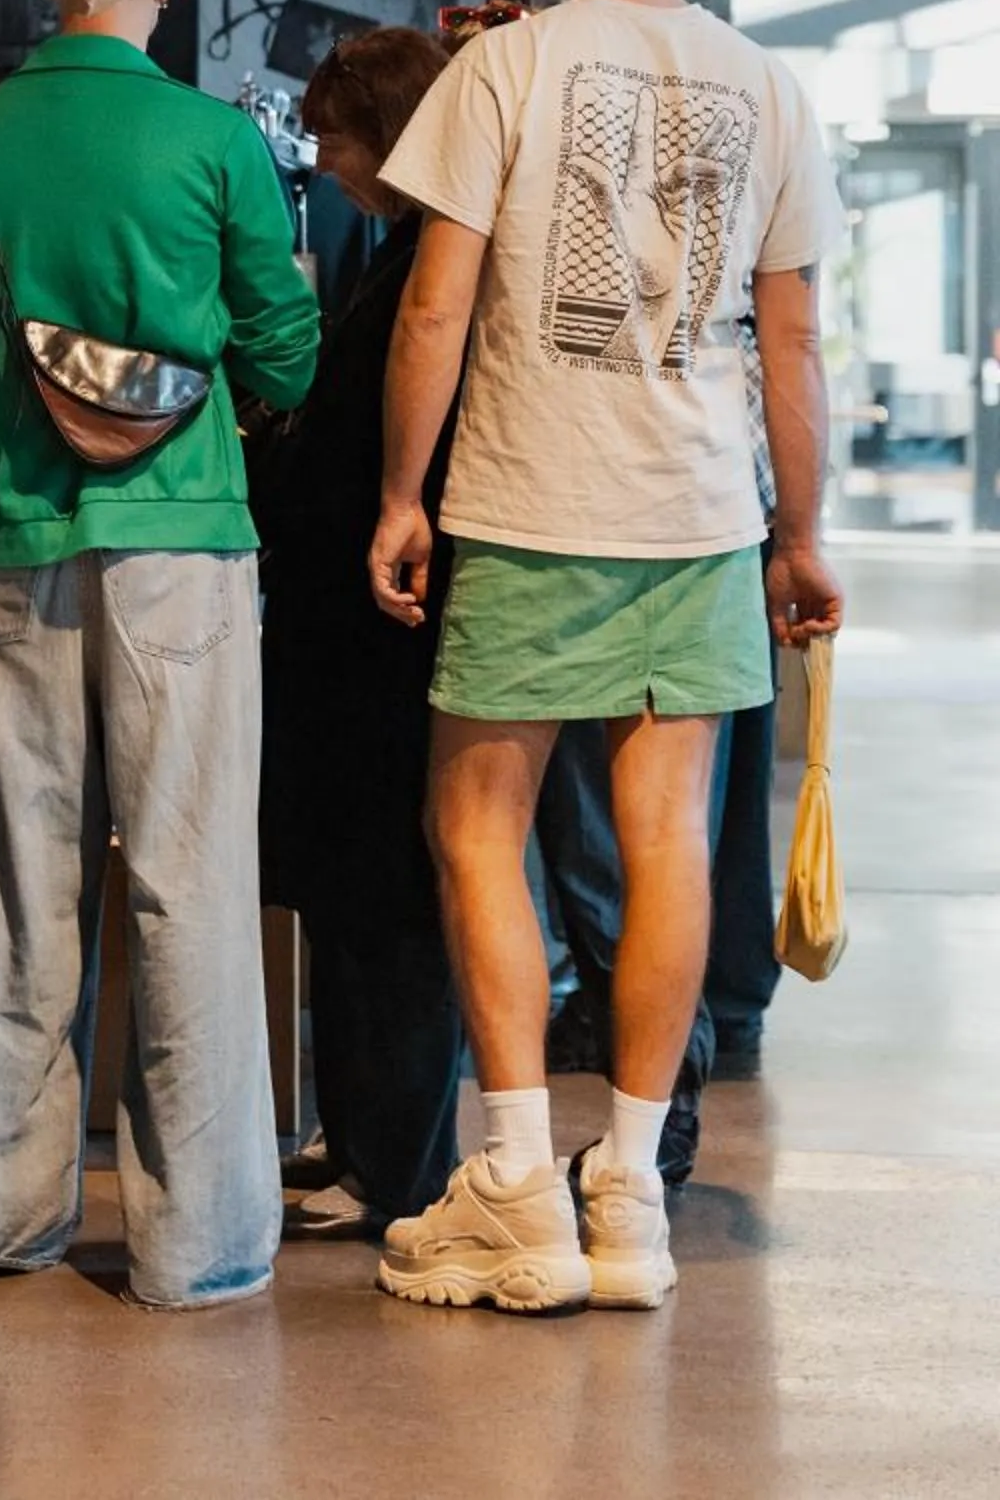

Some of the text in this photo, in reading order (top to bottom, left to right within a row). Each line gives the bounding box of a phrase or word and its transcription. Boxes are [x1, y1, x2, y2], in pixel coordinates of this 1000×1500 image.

[595, 62, 730, 96] FUCK ISRAELI OCCUPATION
[551, 181, 568, 210] FUCK
[538, 219, 562, 363] FUCK ISRAELI OCCUPATION
